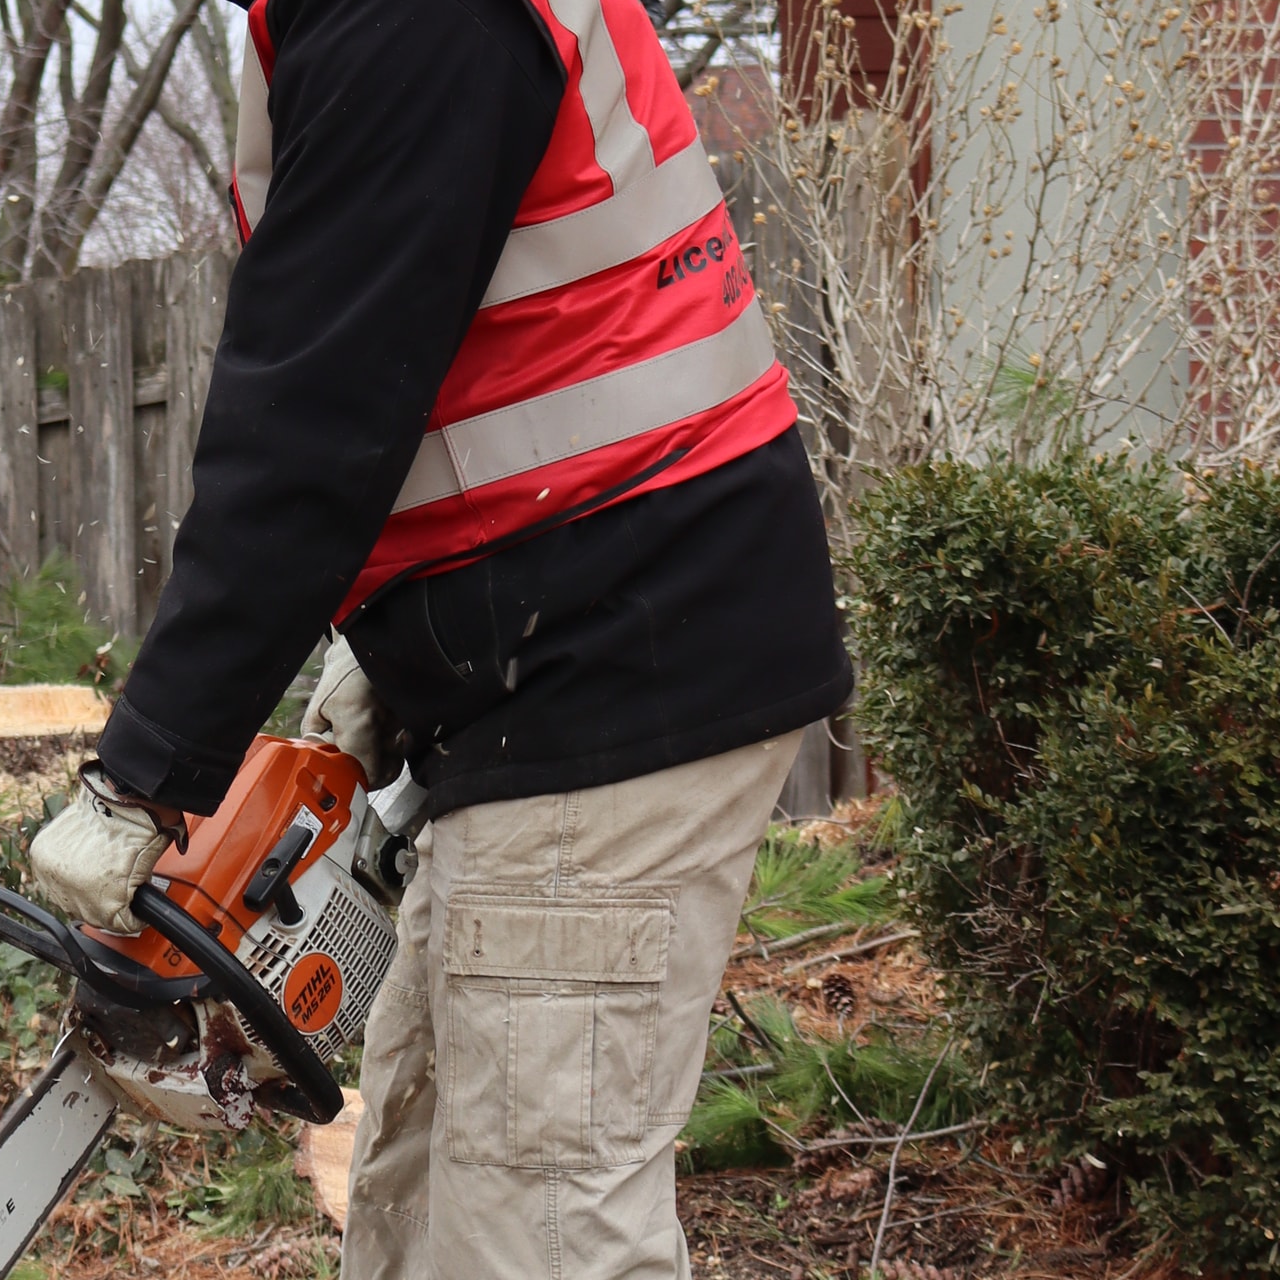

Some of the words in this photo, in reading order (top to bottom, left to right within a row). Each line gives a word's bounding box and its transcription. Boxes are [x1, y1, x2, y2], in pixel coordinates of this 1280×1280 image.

[291, 963, 332, 1019] STIHL
[301, 997, 319, 1025] MS
[6, 1197, 16, 1215] E
